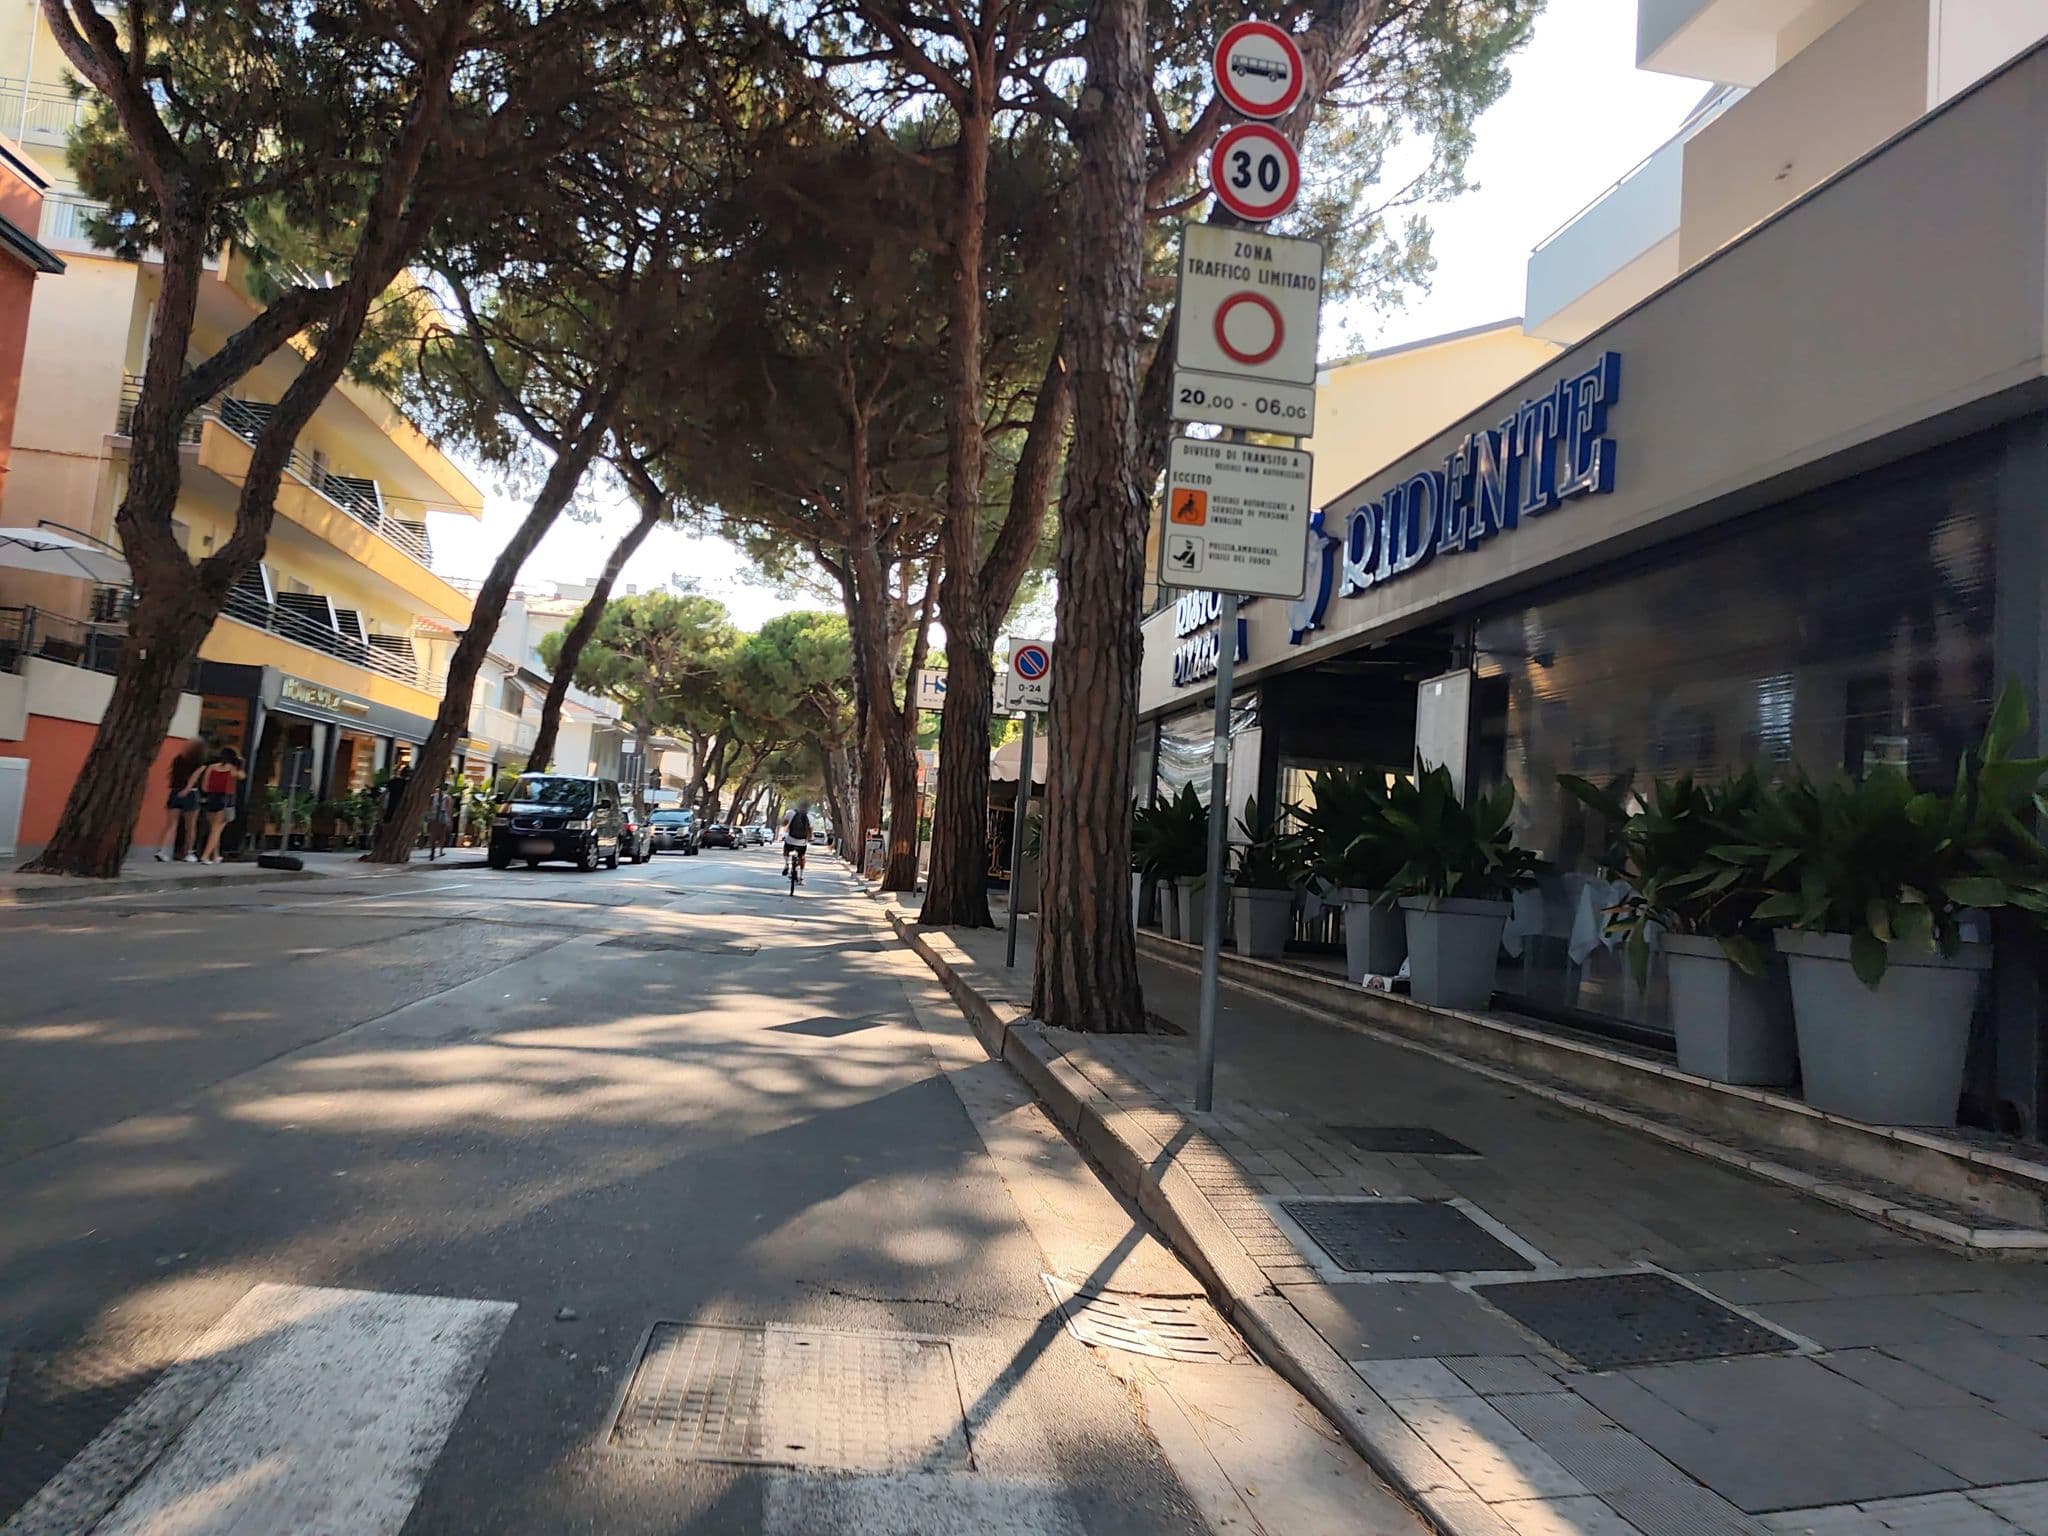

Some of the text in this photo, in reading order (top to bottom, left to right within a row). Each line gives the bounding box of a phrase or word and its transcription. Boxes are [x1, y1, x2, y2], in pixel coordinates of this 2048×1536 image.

[1231, 150, 1281, 192] 30
[1234, 242, 1273, 262] ZONA
[1188, 258, 1317, 292] TRAFFICO LIMITATO
[1180, 388, 1234, 410] 20.00
[1183, 444, 1299, 468] DIVIETO DI TRANSITO A
[1172, 471, 1213, 486] ECCETTO
[1248, 557, 1271, 567] FUOCO
[1018, 682, 1042, 693] 0-24
